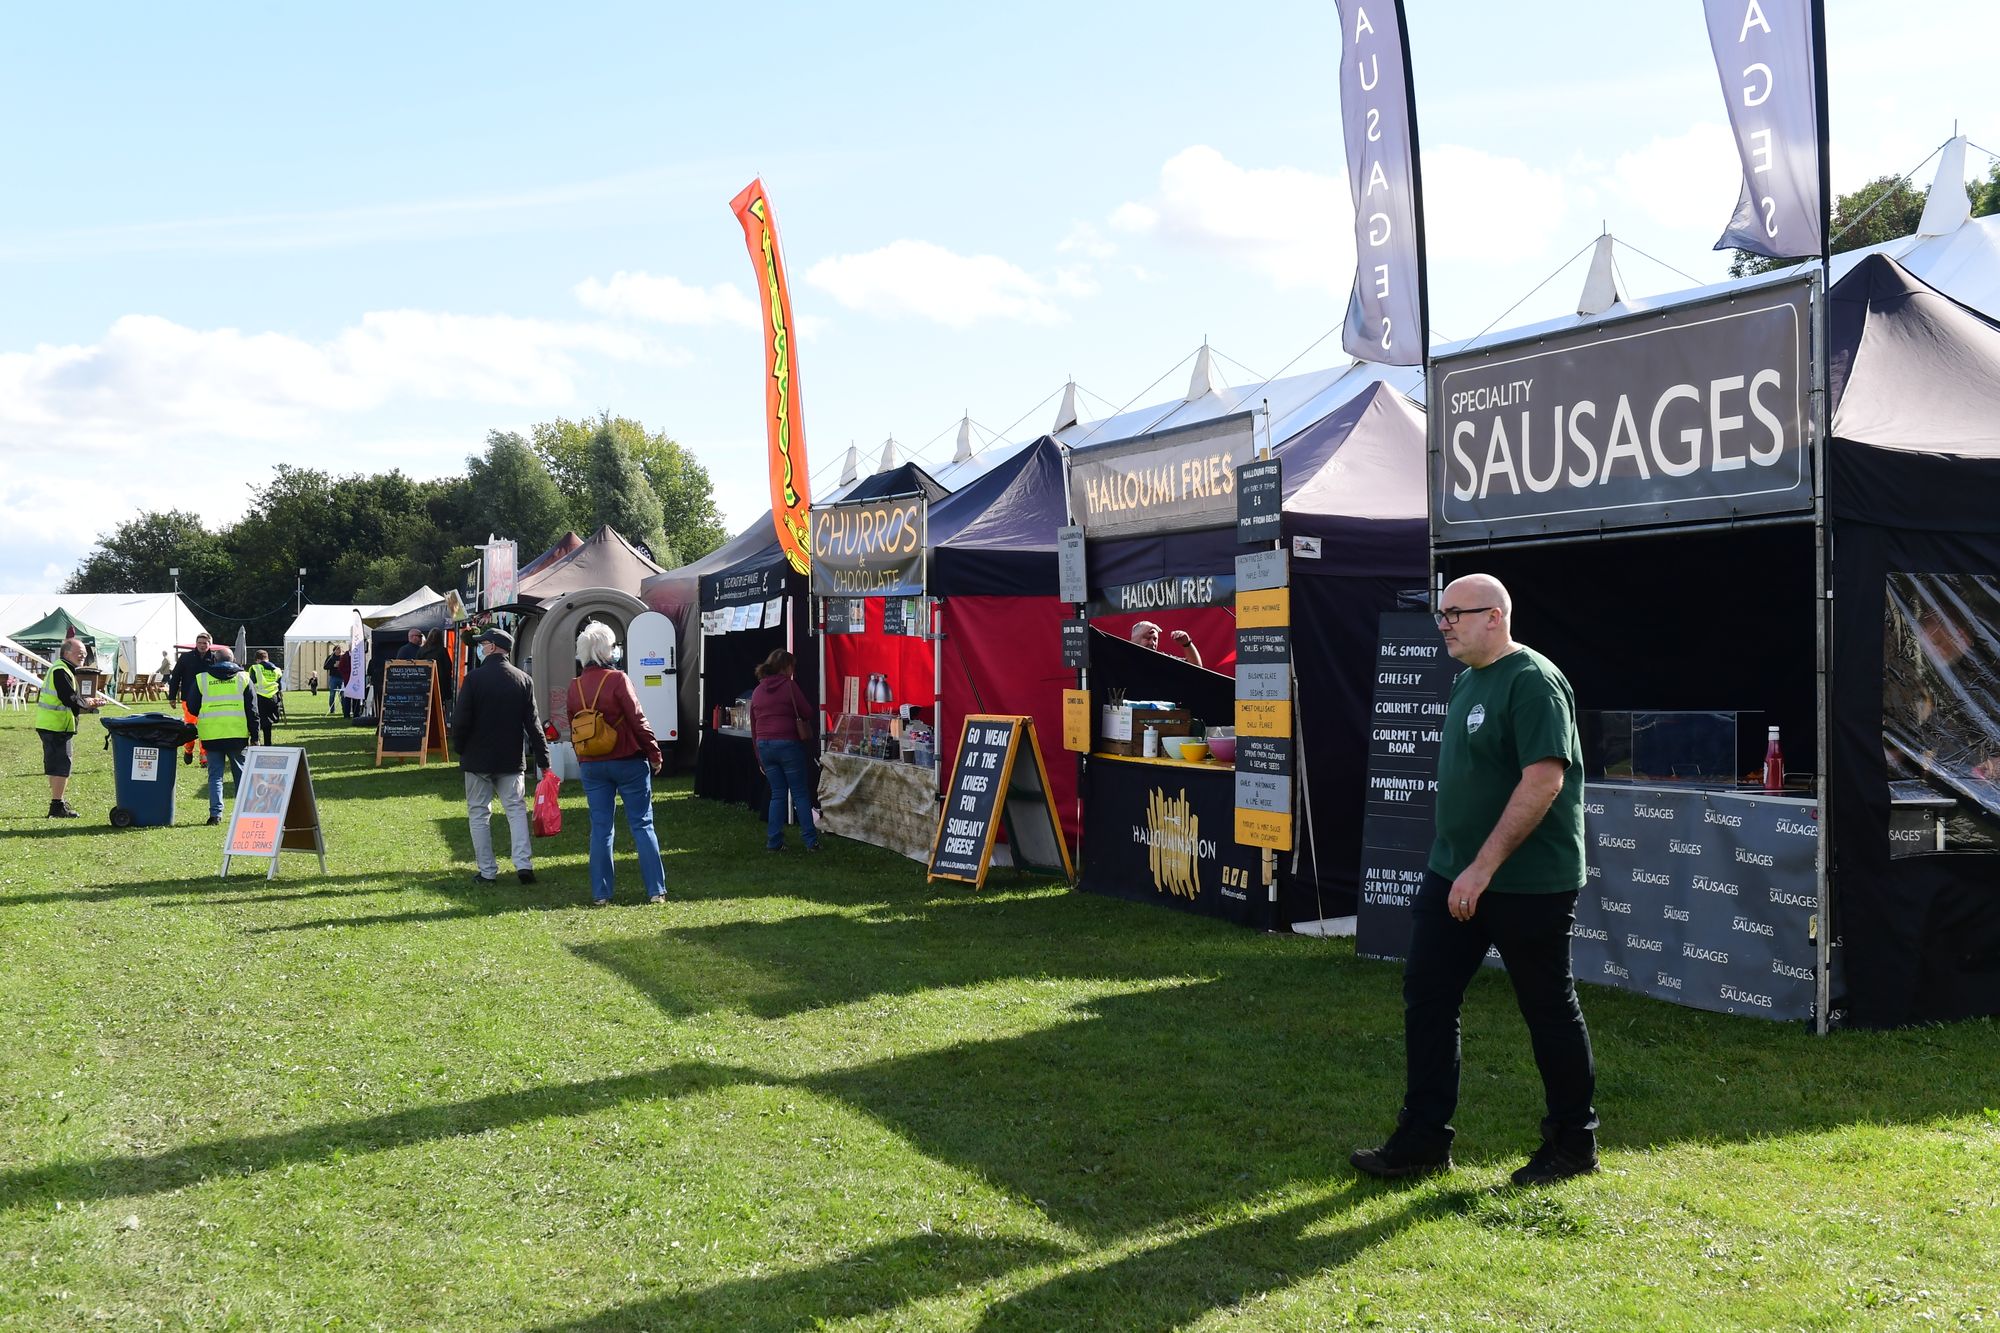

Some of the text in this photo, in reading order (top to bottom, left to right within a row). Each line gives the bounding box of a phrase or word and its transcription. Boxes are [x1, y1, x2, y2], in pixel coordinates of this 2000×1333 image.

[1451, 379, 1533, 415] SPECIALITY
[1453, 368, 1784, 501] SAUSAGES
[1086, 452, 1234, 514] HALLOUMI FRIES
[1240, 518, 1252, 526] PICK
[1252, 515, 1266, 525] FROM
[816, 505, 917, 557] CHURROS
[859, 552, 866, 568] &
[833, 569, 900, 592] CHOCOLATE
[1121, 577, 1213, 609] HALLOUMI FRIES
[1381, 642, 1438, 658] BIG SMOKEY
[1378, 672, 1422, 685] CHEESEY
[1375, 702, 1418, 714] GOURMET
[967, 727, 1010, 747] GO WEAK
[1372, 729, 1418, 742] GOURMET
[134, 748, 158, 756] LITTER
[1388, 742, 1416, 754] BOAR
[965, 752, 998, 769] AT THE
[961, 774, 989, 792] KNEES
[1370, 776, 1424, 791] MARINATED
[960, 794, 977, 812] FOR
[1384, 790, 1412, 802] BELLY
[1634, 806, 1674, 820] SAUSAGES
[1704, 812, 1742, 827] SAUSAGES
[252, 820, 264, 829] TEA
[947, 817, 984, 838] SQUEAKY
[1776, 821, 1818, 837] SAUSAGES
[242, 830, 266, 840] COFFEE
[1132, 825, 1216, 860] HALLOUMINATION
[1599, 836, 1636, 850] SAUSAGES
[232, 841, 273, 850] COLD DRINKS
[945, 836, 976, 856] CHEESE
[1669, 842, 1702, 856] SAUSAGES
[1735, 851, 1774, 867] SAUSAGES
[1366, 868, 1381, 880] ALL
[1382, 868, 1396, 881] OUR
[1632, 871, 1670, 886] SAUSAGES
[1364, 880, 1400, 894] SERVED
[1401, 883, 1414, 895] ON
[1692, 878, 1739, 896] SAUSAGES
[1601, 900, 1632, 914] SAUSAGES
[1769, 891, 1818, 908] SAUSAGES
[1663, 908, 1690, 922] SAUSAGES
[1574, 927, 1608, 941] SAUSAGES
[1732, 919, 1774, 937] SAUSAGES
[1626, 937, 1663, 952] SAUSAGES
[1682, 946, 1729, 964] SAUSAGES
[1772, 962, 1814, 981] SAUSAGES
[1720, 987, 1772, 1007] SAUSAGES
